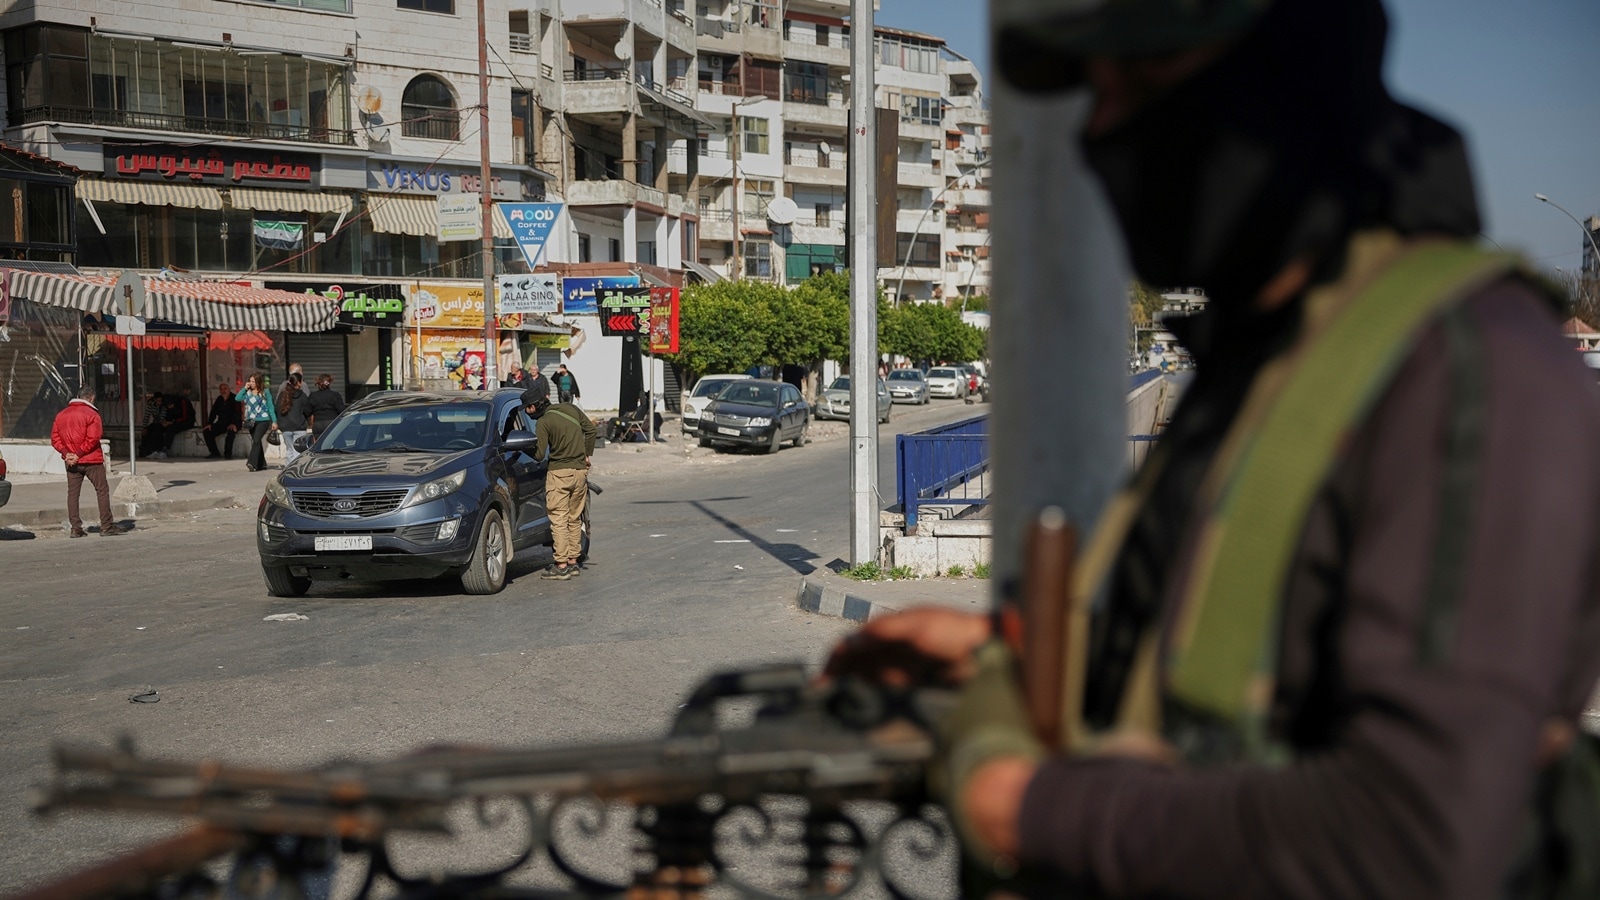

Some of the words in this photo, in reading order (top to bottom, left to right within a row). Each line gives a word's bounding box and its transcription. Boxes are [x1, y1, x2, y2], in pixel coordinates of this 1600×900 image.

[231, 155, 311, 181] مطعم
[380, 163, 451, 192] VENUS
[460, 173, 505, 196] RET.
[510, 209, 555, 221] MOOD
[517, 221, 547, 229] COFFEE
[528, 229, 536, 237] &
[504, 292, 529, 301] ALAA
[530, 291, 554, 301] SINO
[341, 291, 403, 319] صيدلية
[442, 296, 473, 314] فراس
